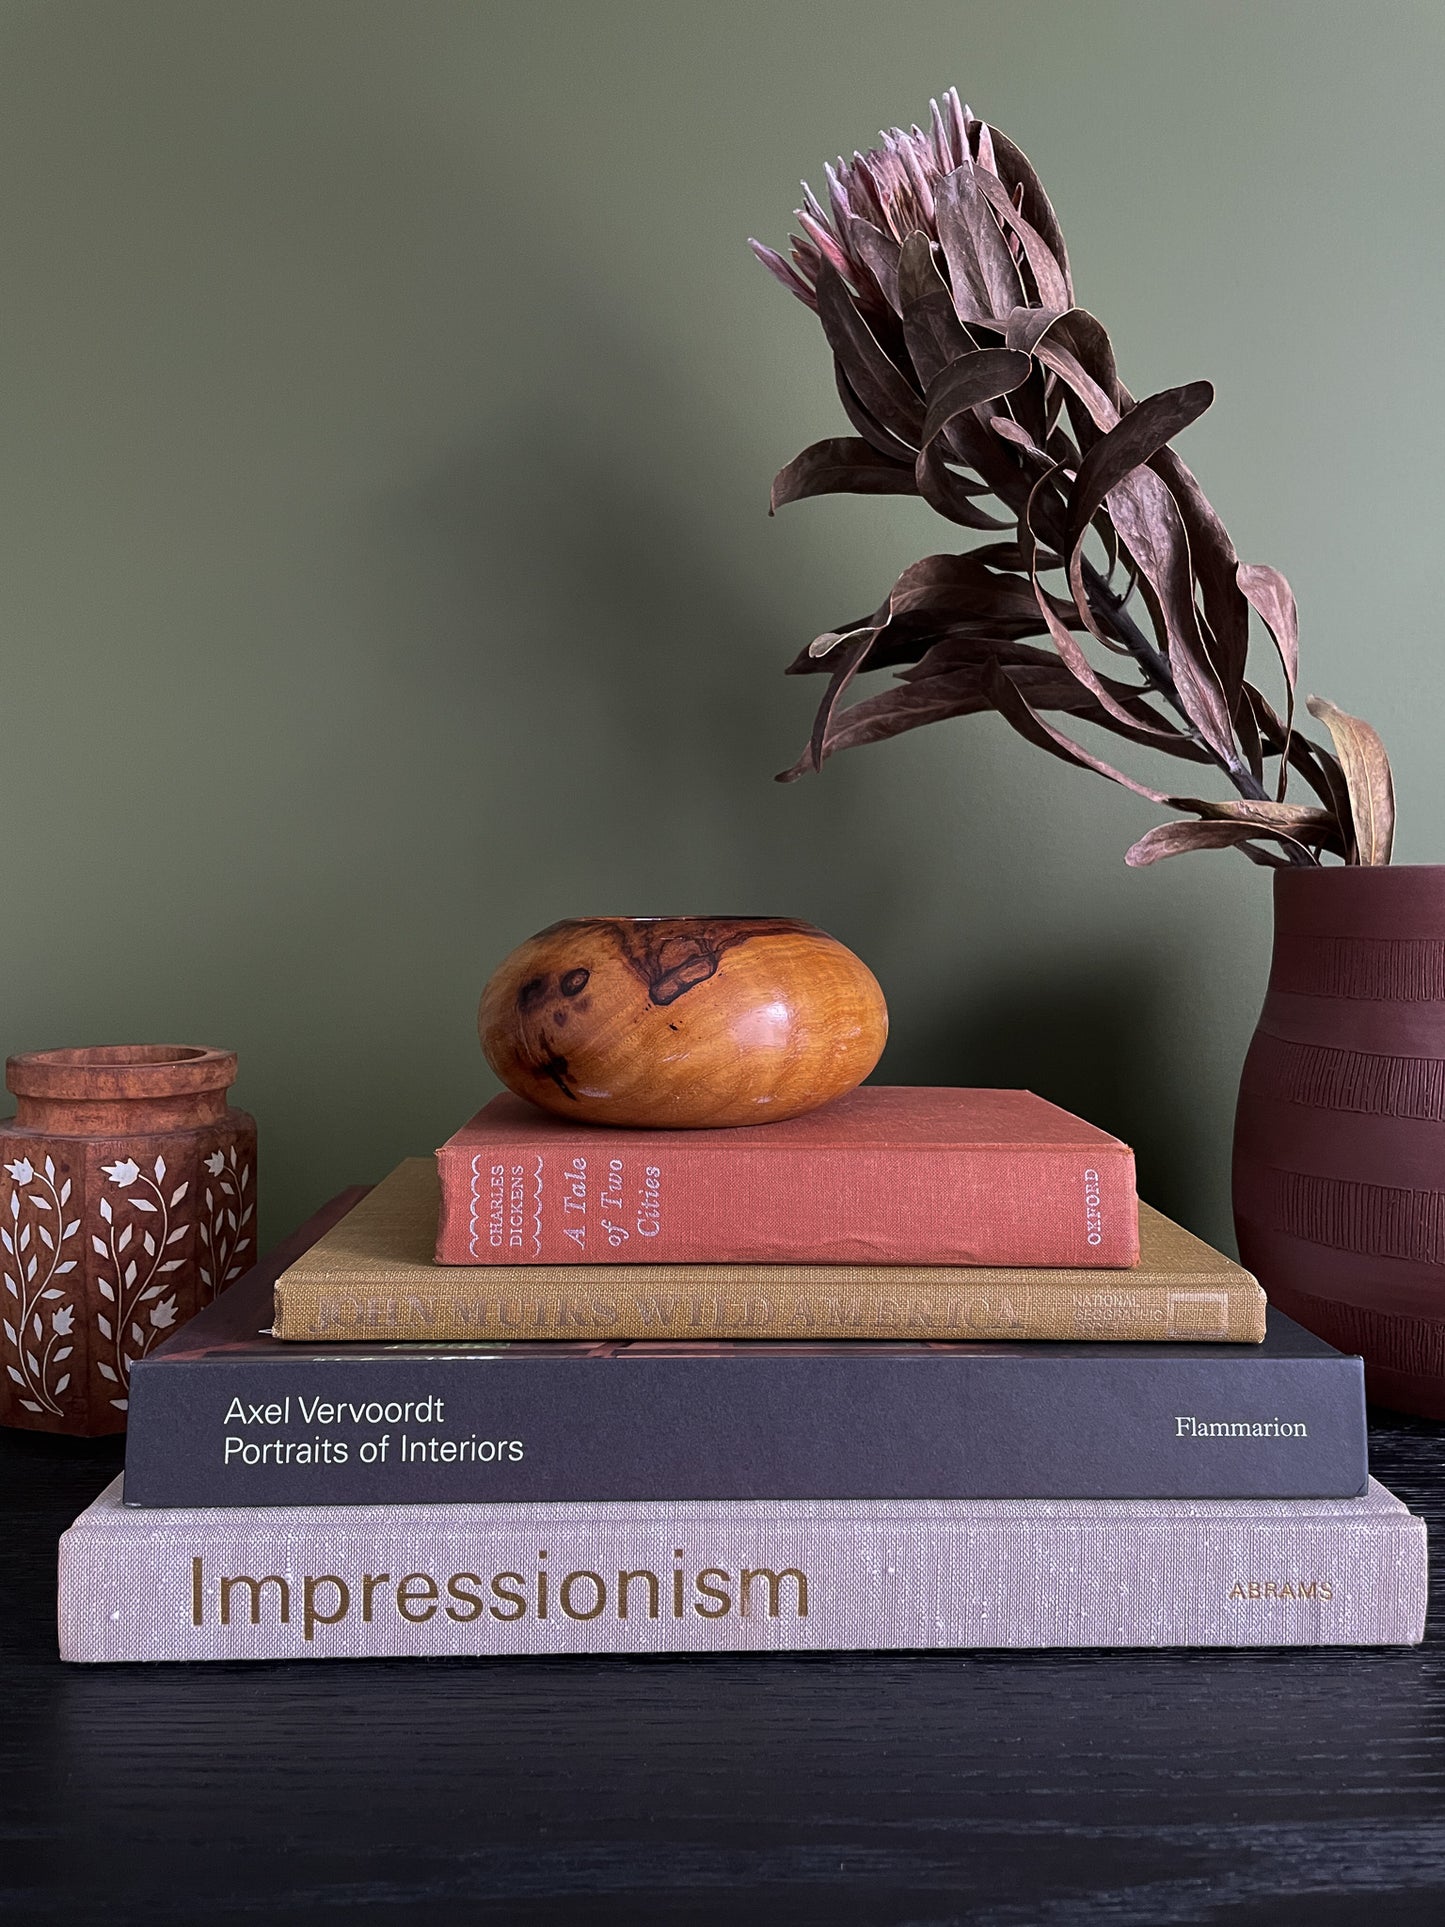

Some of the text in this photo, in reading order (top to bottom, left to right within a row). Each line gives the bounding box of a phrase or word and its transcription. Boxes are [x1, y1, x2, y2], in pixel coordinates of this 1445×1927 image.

[490, 1164, 504, 1247] CHARLES
[509, 1165, 524, 1247] DICKENS
[563, 1157, 587, 1250] A Tale
[601, 1159, 630, 1248] of Two
[637, 1166, 661, 1238] Cities
[1084, 1169, 1102, 1246] OXFORD
[307, 1294, 437, 1333] JOHN
[634, 1294, 776, 1329] WILD
[788, 1294, 1025, 1330] AMERICA
[1072, 1294, 1141, 1308] NATIONAL
[223, 1395, 444, 1424] Axel Vervoordt
[1175, 1416, 1308, 1437] Flammarion
[224, 1433, 524, 1465] Portraits of Interiors
[191, 1549, 809, 1641] Impressionism
[1228, 1581, 1334, 1601] ABRAMS
